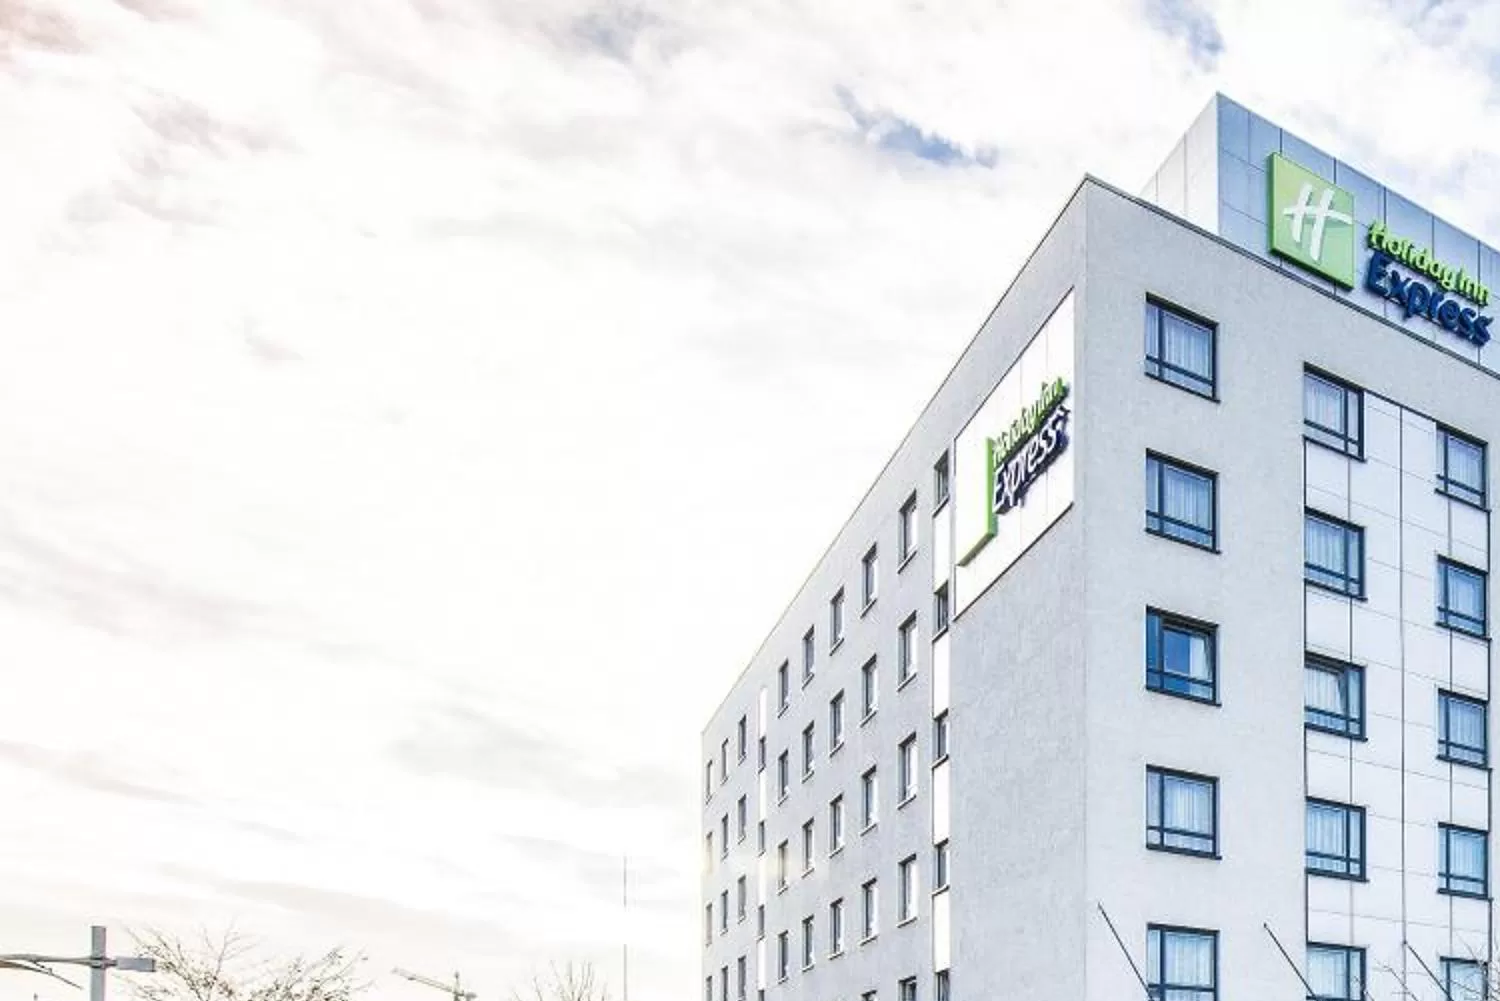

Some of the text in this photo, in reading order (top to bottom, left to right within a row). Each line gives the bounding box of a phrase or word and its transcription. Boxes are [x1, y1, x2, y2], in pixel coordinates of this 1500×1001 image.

[1365, 250, 1494, 346] Express
[1368, 218, 1489, 307] Holiday Inn
[993, 404, 1070, 515] Express
